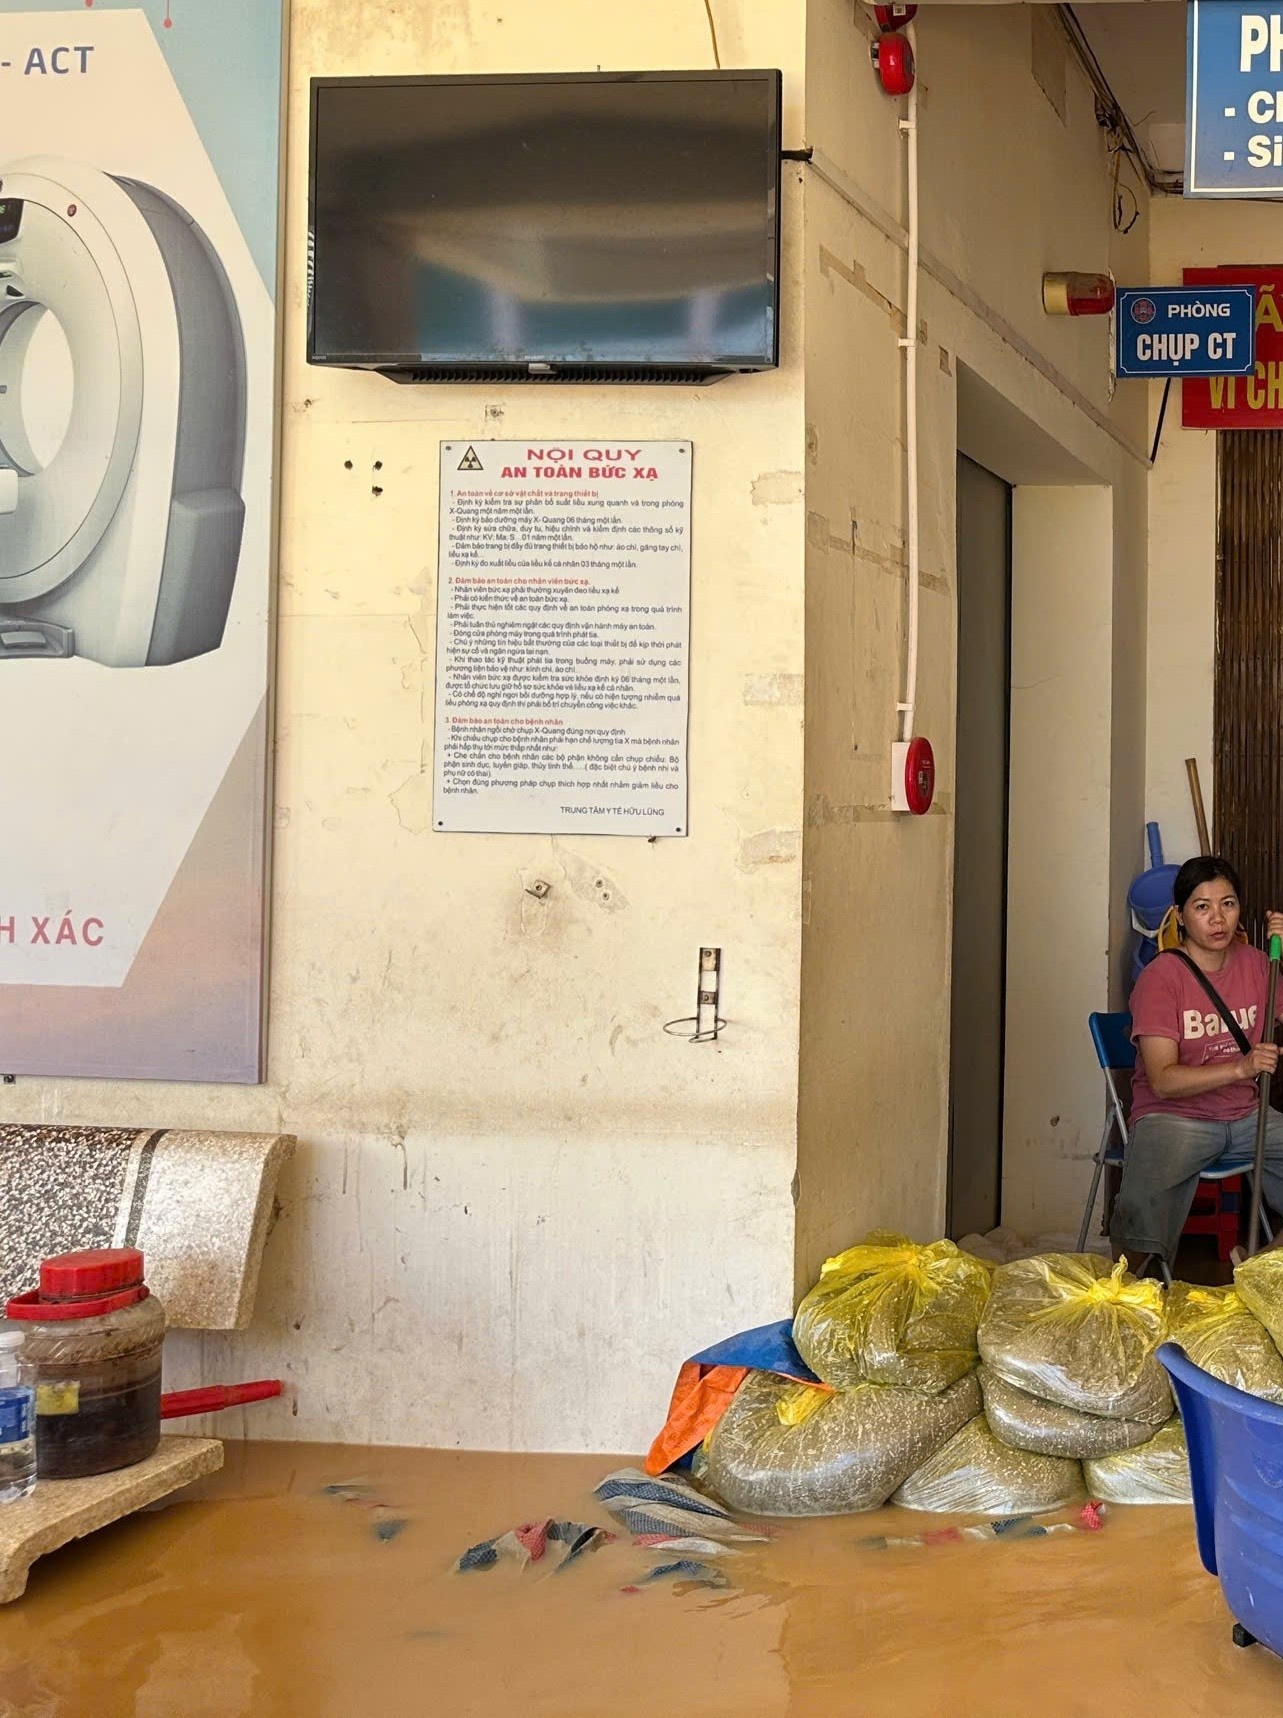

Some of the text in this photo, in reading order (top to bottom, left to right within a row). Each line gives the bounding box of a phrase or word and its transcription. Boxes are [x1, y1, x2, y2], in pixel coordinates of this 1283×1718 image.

[24, 46, 94, 75] ACT
[1168, 301, 1230, 318] PHÒNG
[1137, 332, 1236, 366] CHỤP CT
[528, 448, 642, 463] NỘI QUY
[501, 464, 658, 481] AN TOÀN BỨC XẠ
[560, 806, 588, 814] TRUNG
[31, 909, 104, 946] XÁC
